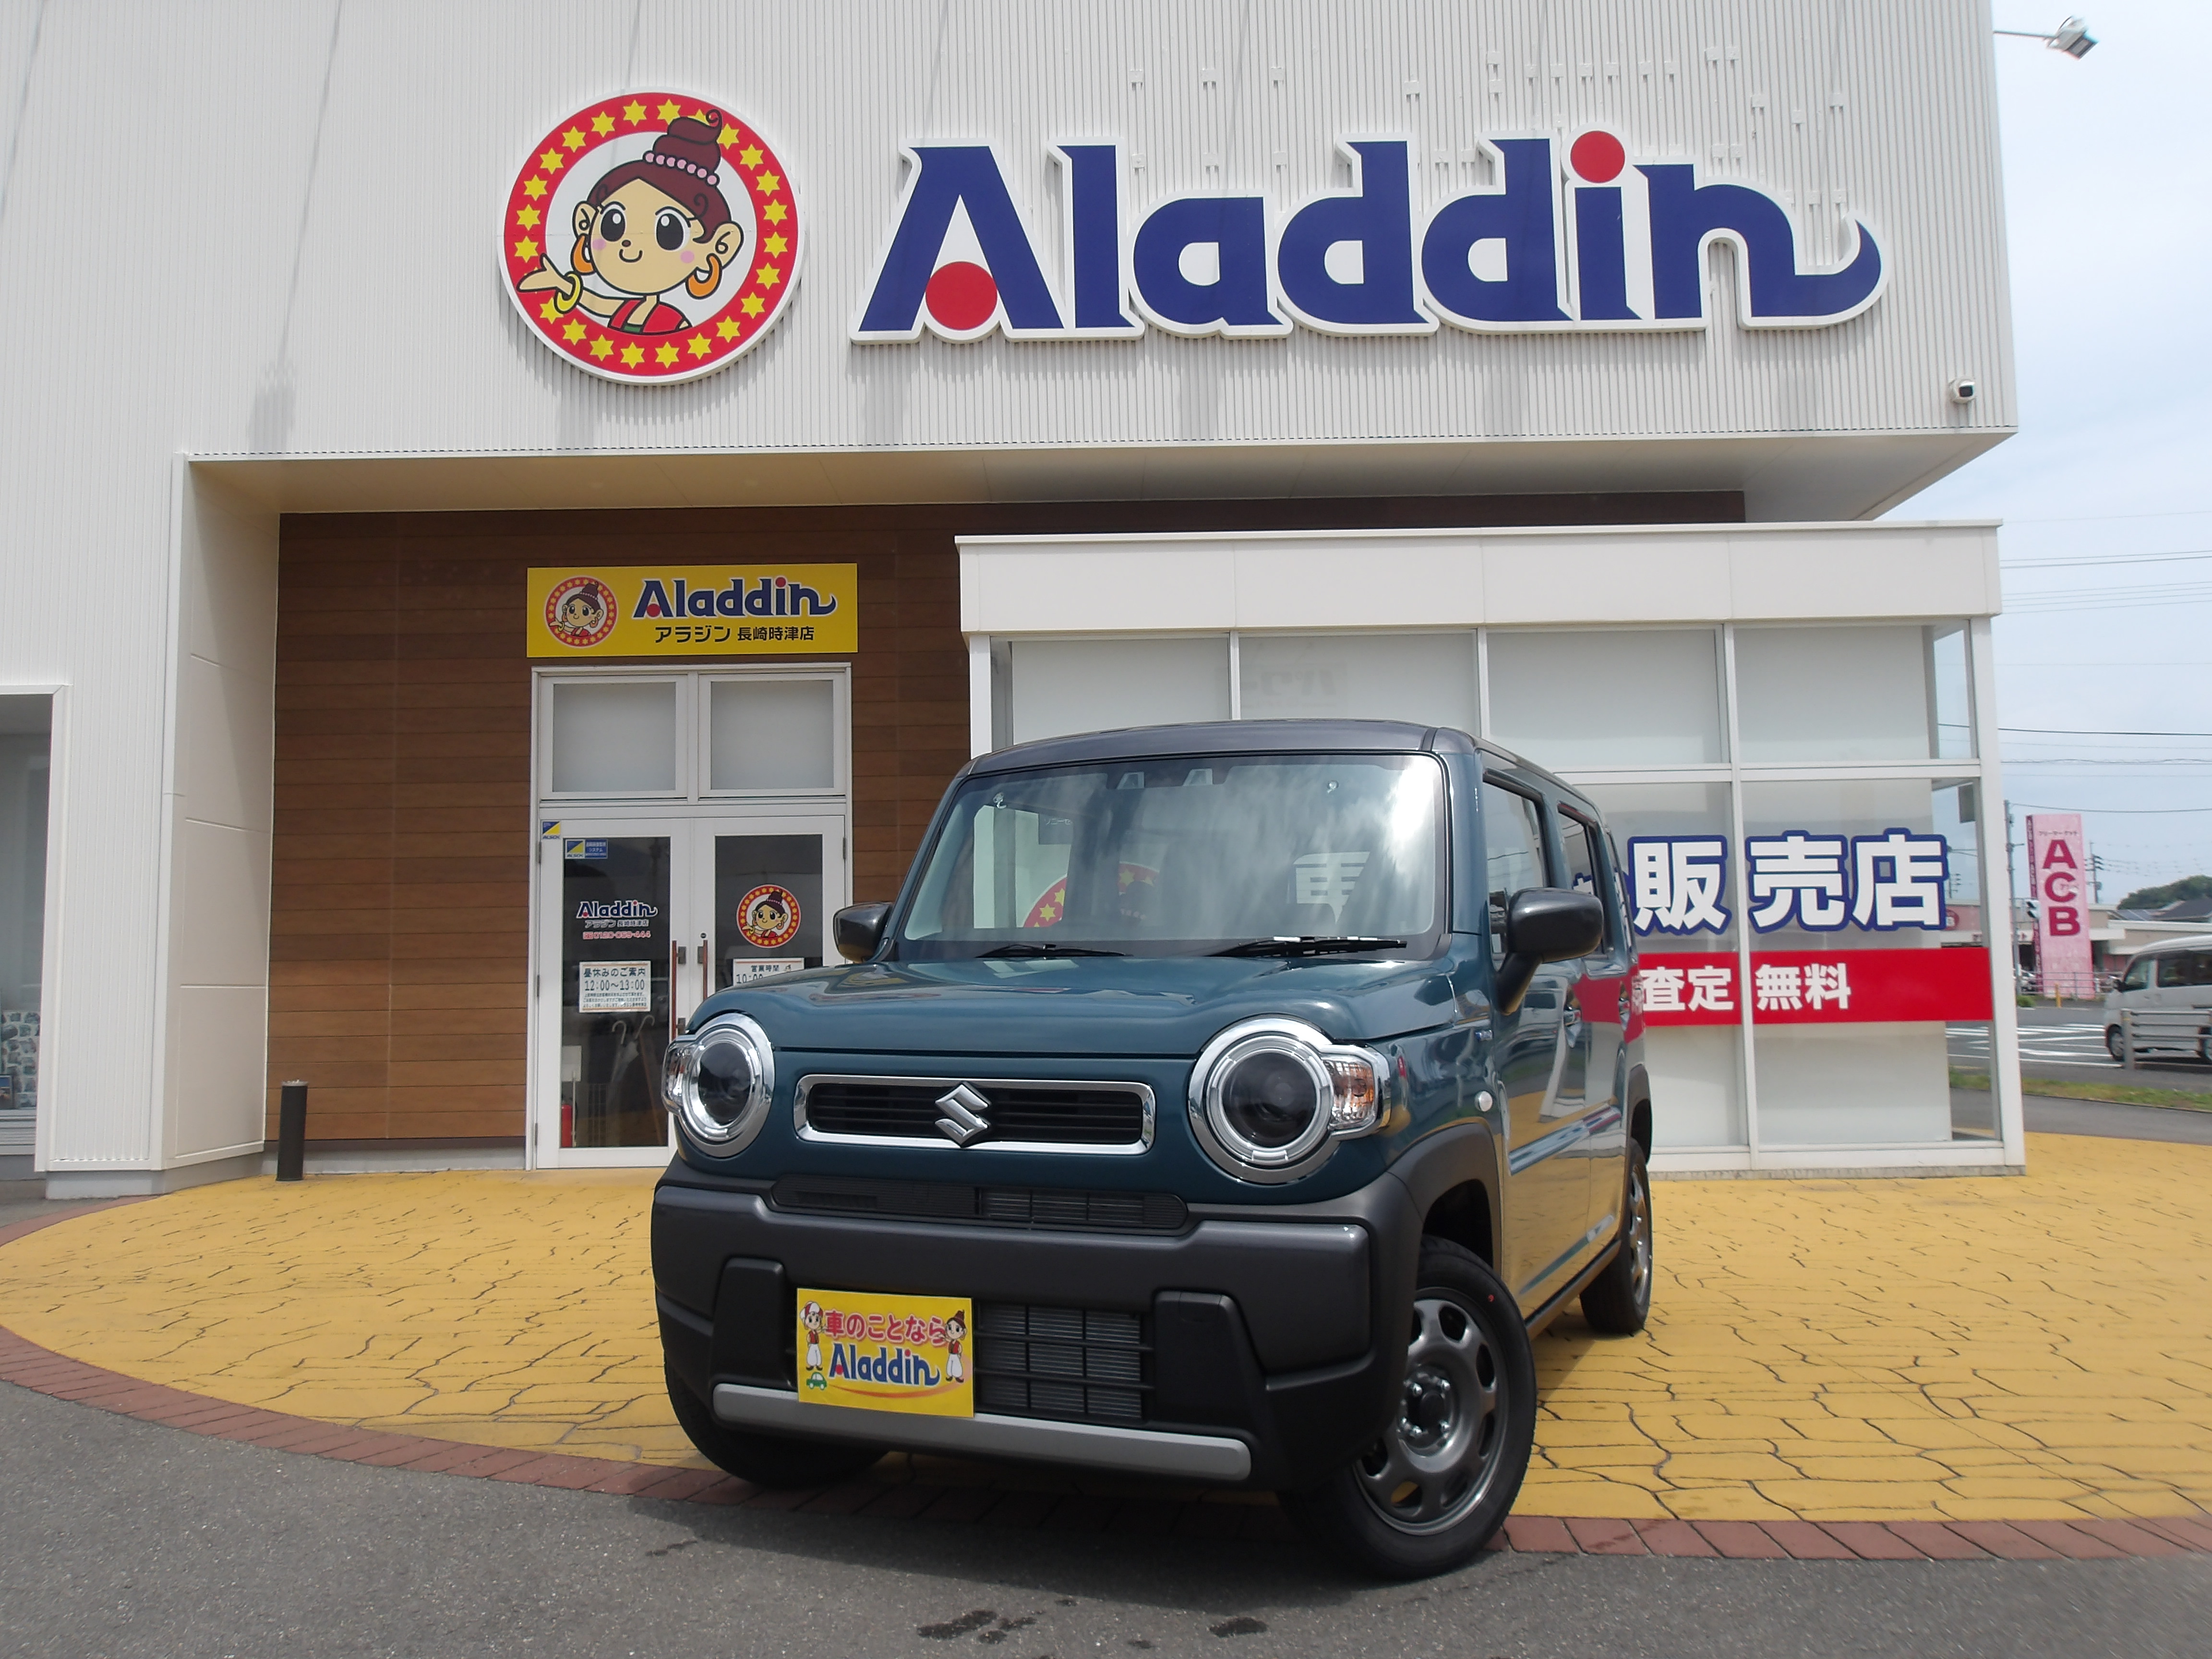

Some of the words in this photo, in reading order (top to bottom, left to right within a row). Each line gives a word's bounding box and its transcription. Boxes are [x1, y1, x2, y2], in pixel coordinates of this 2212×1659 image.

[852, 128, 1887, 338] Aladdin
[632, 576, 838, 619] Aladdin
[655, 625, 731, 643] アラジン
[737, 626, 815, 641] 長崎時津店
[1629, 828, 1948, 935] 販売店
[576, 899, 658, 919] Aladdin
[585, 919, 616, 928] アラジン
[583, 967, 646, 977] 昼休みのご案内
[1639, 962, 1851, 1011] 査定無料
[824, 1310, 948, 1348] 車のことなら
[828, 1342, 941, 1387] Aladdin
